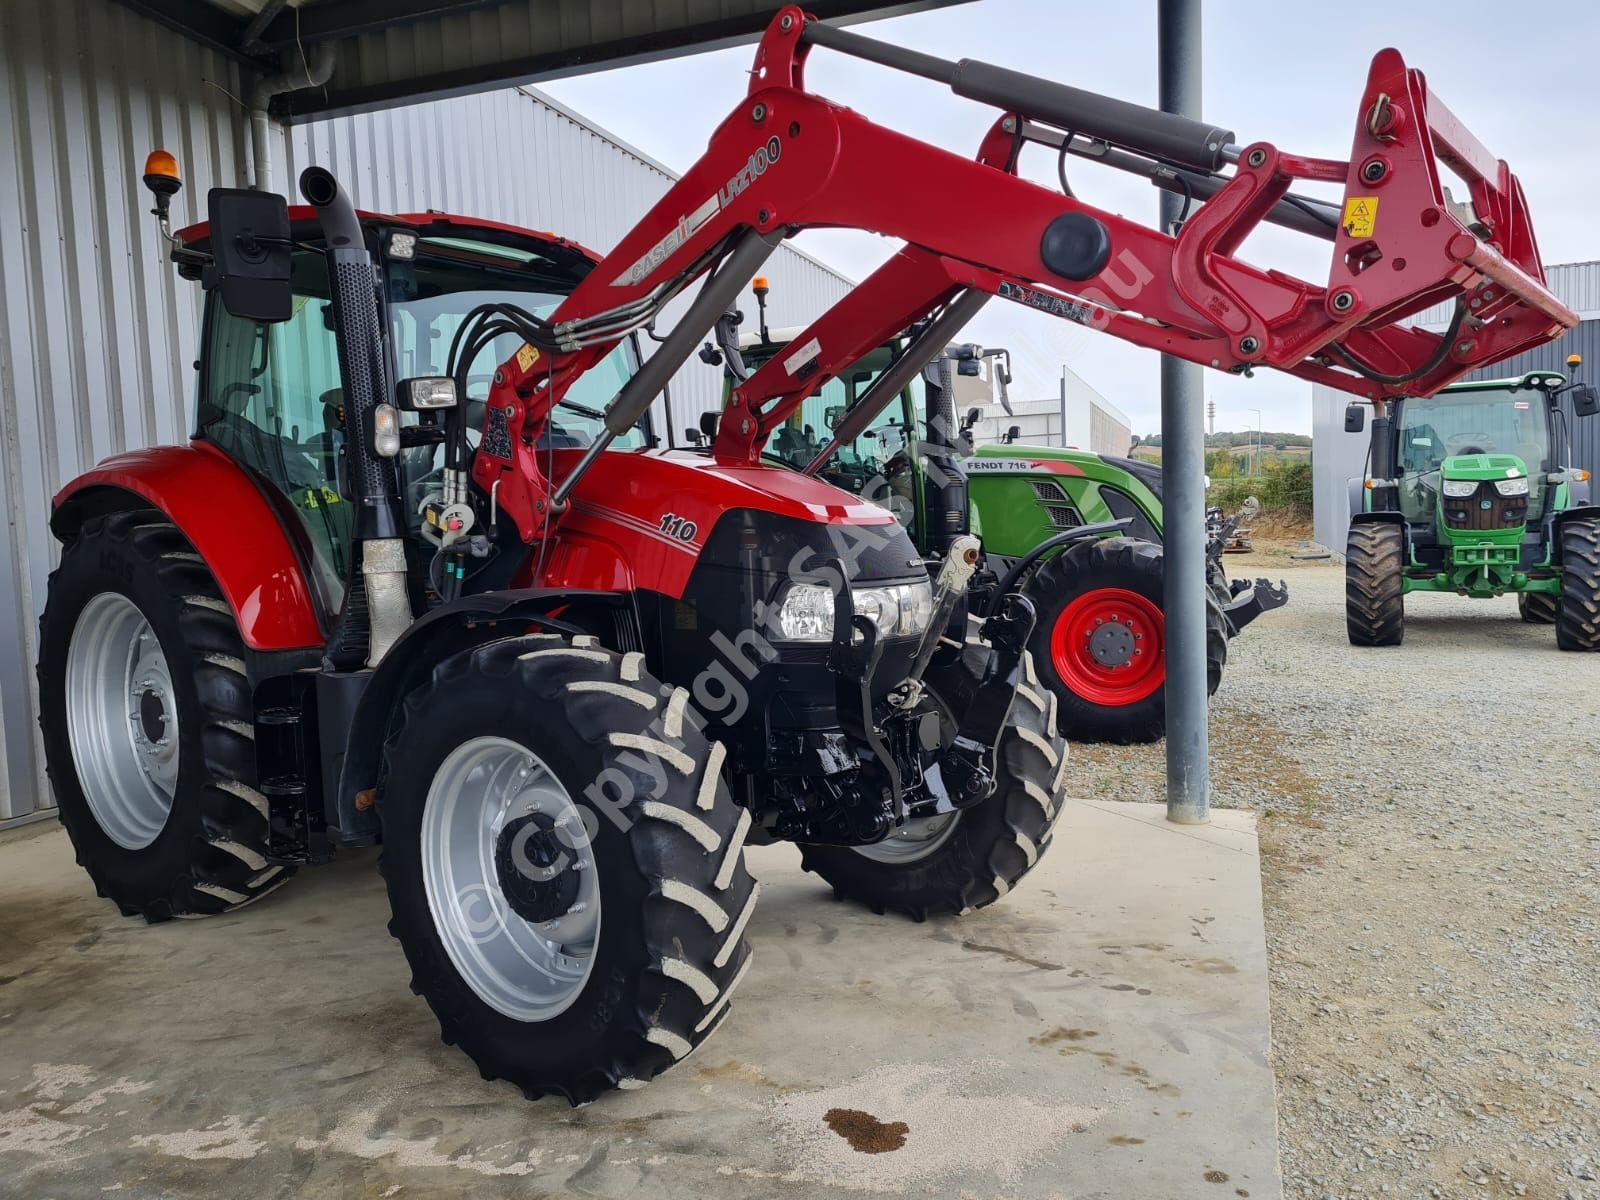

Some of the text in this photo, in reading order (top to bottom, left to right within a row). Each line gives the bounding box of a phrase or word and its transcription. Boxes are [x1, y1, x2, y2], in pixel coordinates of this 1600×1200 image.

[718, 135, 781, 210] LRZ100
[631, 232, 676, 280] CASE
[659, 513, 697, 543] 110
